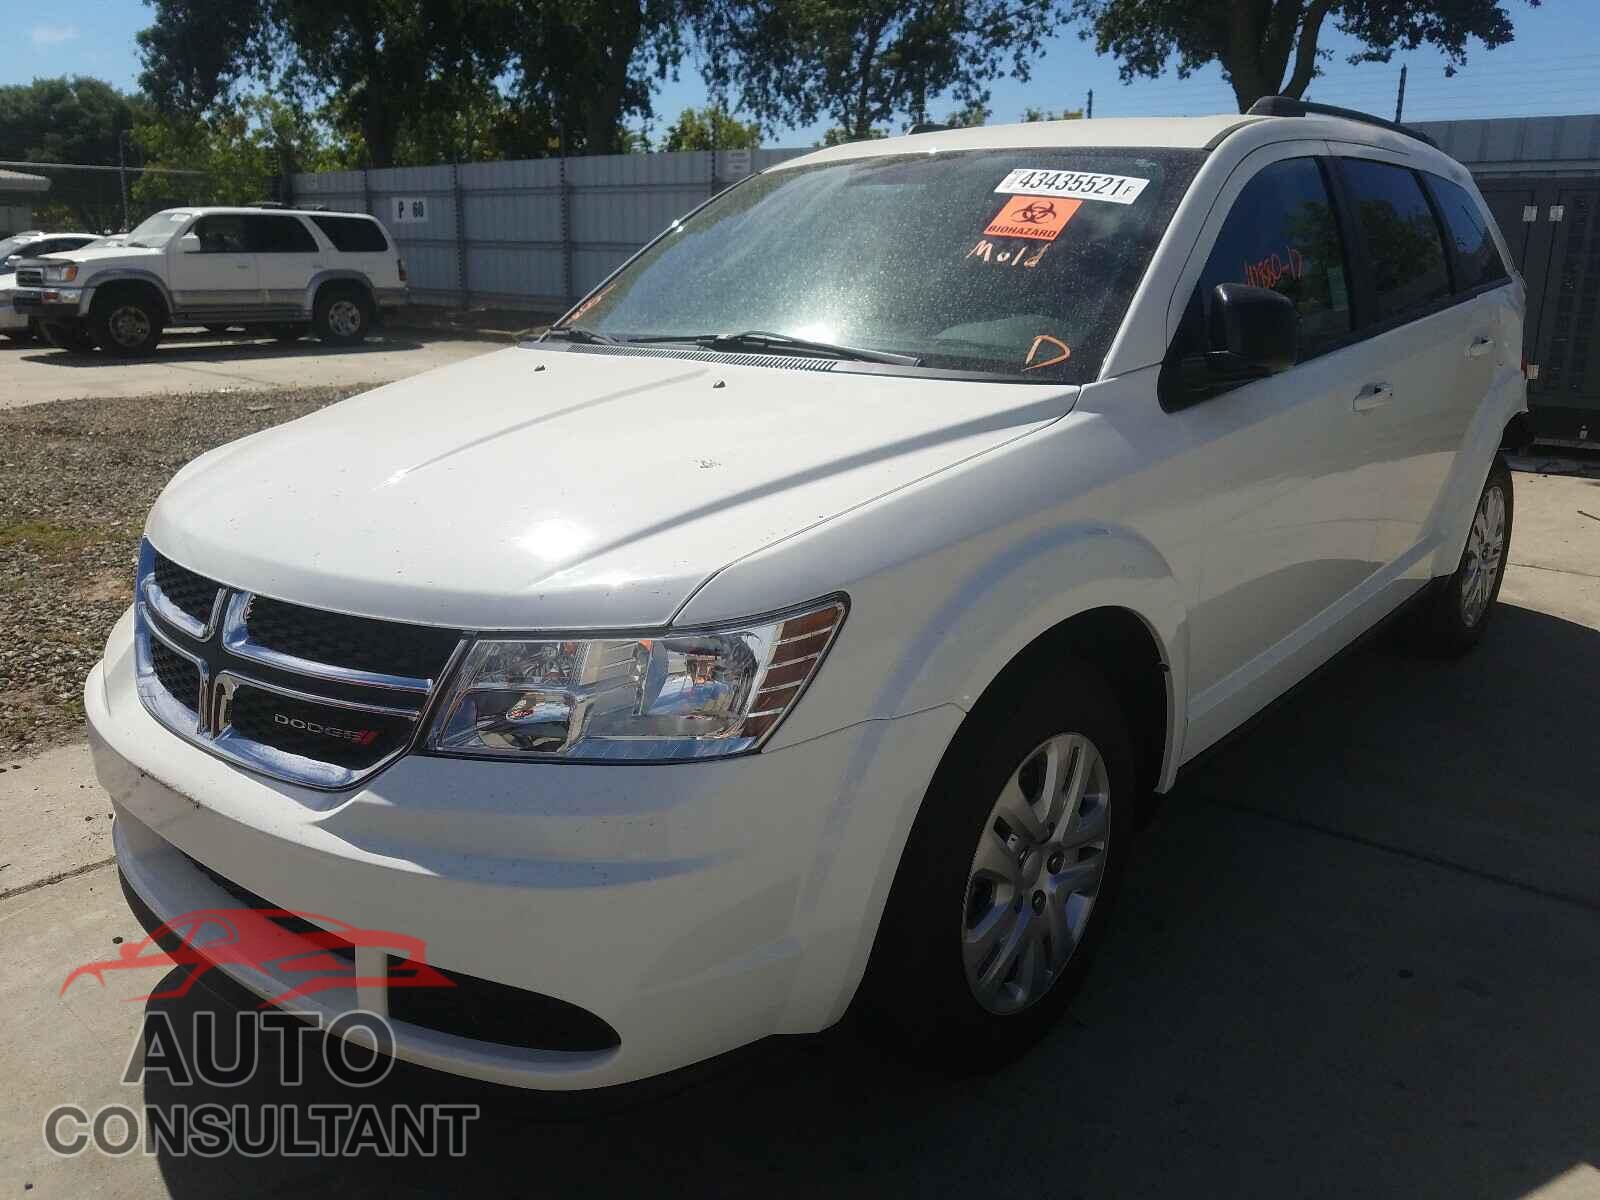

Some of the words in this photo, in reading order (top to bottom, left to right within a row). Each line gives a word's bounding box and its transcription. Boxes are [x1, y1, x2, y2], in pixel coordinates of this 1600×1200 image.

[1019, 171, 1126, 197] 43435521
[1123, 185, 1132, 196] F
[987, 224, 1057, 238] BIOHAZARD
[966, 239, 1052, 268] Mold
[1021, 334, 1071, 372] D
[274, 713, 362, 742] DODGE
